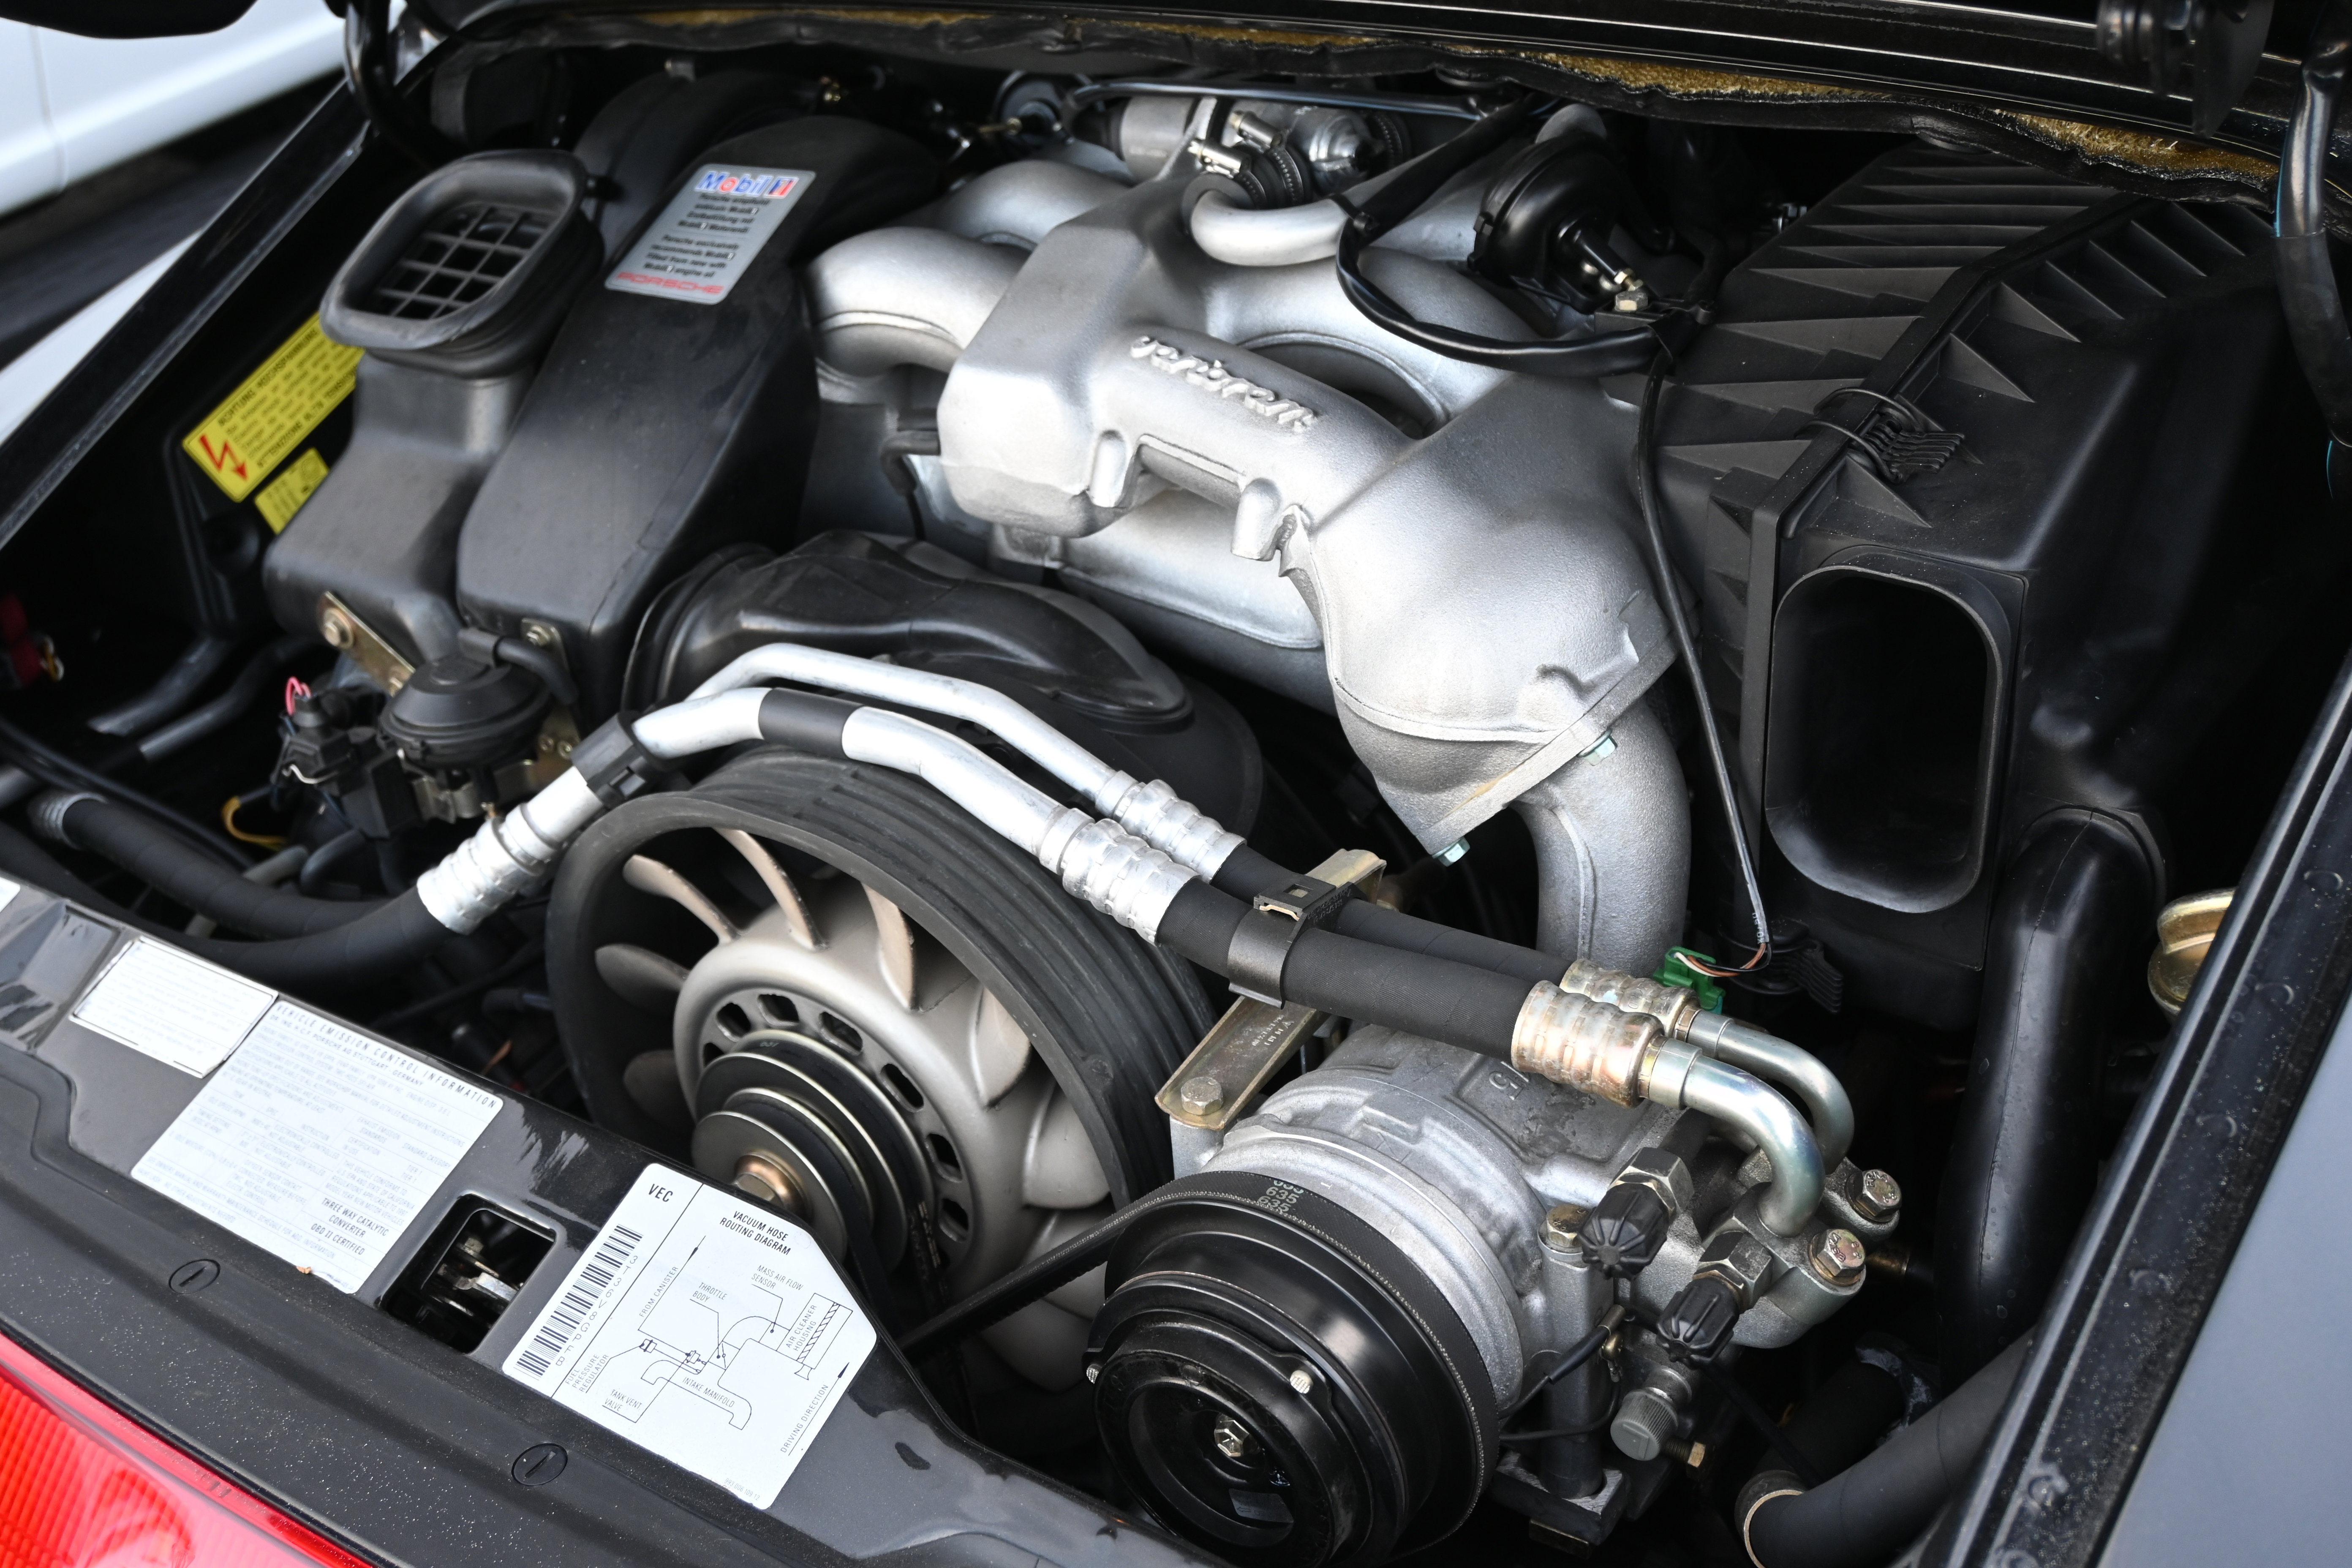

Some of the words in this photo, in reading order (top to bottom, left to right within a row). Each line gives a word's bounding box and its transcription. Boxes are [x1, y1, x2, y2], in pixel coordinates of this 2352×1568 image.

[695, 172, 773, 196] Mobil
[617, 272, 724, 294] PORSCHE
[275, 1004, 317, 1027] VEHICLE
[319, 1024, 369, 1051] EMISSION
[373, 1048, 419, 1073] CONTROL
[422, 1070, 496, 1108] INFORMATION
[312, 1033, 342, 1050] PORSCHE
[352, 1051, 388, 1070] STUTTGART
[392, 1069, 423, 1087] GERMANY
[426, 1154, 451, 1169] CATEGORY
[648, 1184, 673, 1202] VEC
[1258, 1195, 1292, 1212] 635
[1266, 1186, 1300, 1204] 635
[321, 1198, 342, 1212] THREE
[342, 1208, 357, 1220] WAY
[356, 1215, 389, 1236] CATALYTIC
[328, 1214, 366, 1238] CONVERTER
[733, 1211, 767, 1231] VACUUM
[767, 1227, 789, 1241] HOSE
[310, 1222, 326, 1234] OBD
[325, 1230, 333, 1238] II
[332, 1233, 365, 1255] CERTIFIED
[719, 1217, 754, 1238] ROUTING
[754, 1234, 791, 1255] DIAGRAM
[751, 1273, 776, 1290] SENSOR
[757, 1265, 774, 1277] MASS
[774, 1273, 786, 1283] AIR
[784, 1278, 804, 1291] FLOW
[639, 1298, 656, 1318] FROM
[653, 1266, 679, 1298] CANISTER
[692, 1290, 710, 1304] BODY
[699, 1282, 728, 1301] THROTTLE
[786, 1336, 797, 1348] AIR
[794, 1304, 817, 1335] CLEANER
[794, 1320, 817, 1351] HOUSING
[565, 1369, 580, 1385] FUEL
[572, 1353, 600, 1389] PRESSURE
[579, 1354, 610, 1393] REGULATOR
[604, 1398, 623, 1412] VALVE
[610, 1389, 626, 1402] TANK
[626, 1396, 642, 1410] VENT
[683, 1377, 704, 1392] INTAKE
[703, 1388, 735, 1408] MANIFOLD
[780, 1423, 803, 1453] DRIVING
[801, 1384, 829, 1422] DIRECTION
